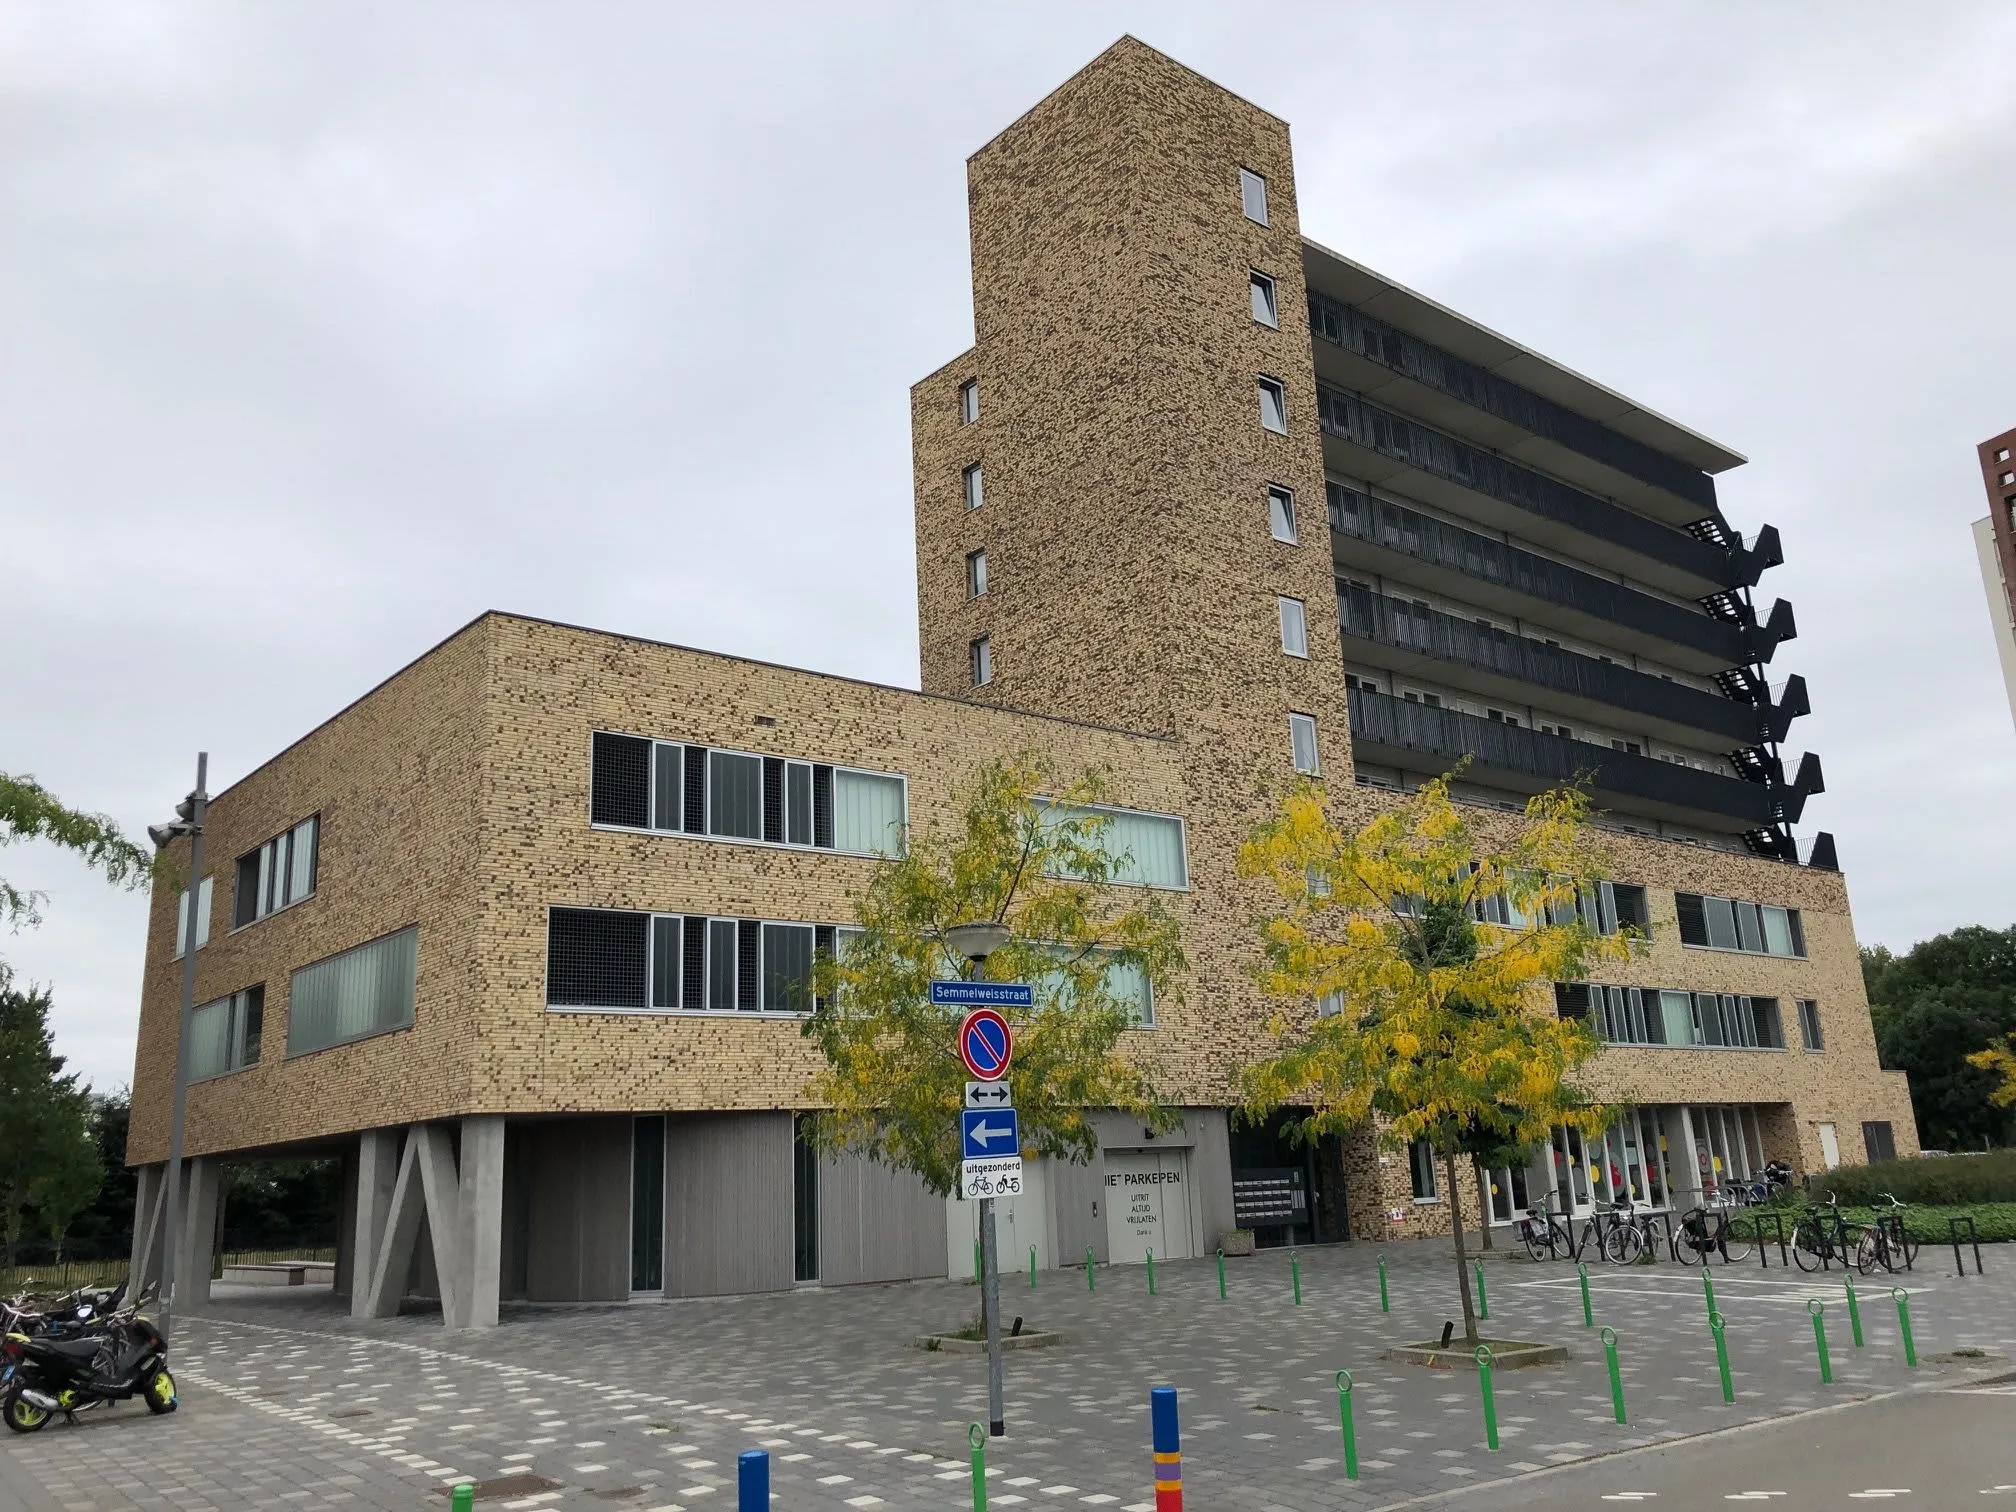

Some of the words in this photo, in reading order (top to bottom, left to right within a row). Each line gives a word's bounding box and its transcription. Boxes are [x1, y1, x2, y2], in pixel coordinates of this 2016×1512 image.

[936, 986, 1029, 1000] Semmelweisstraat
[966, 1162, 1020, 1175] uitgezonderd
[1131, 1194, 1149, 1202] UITRIT
[1131, 1205, 1151, 1213] ALTIJD
